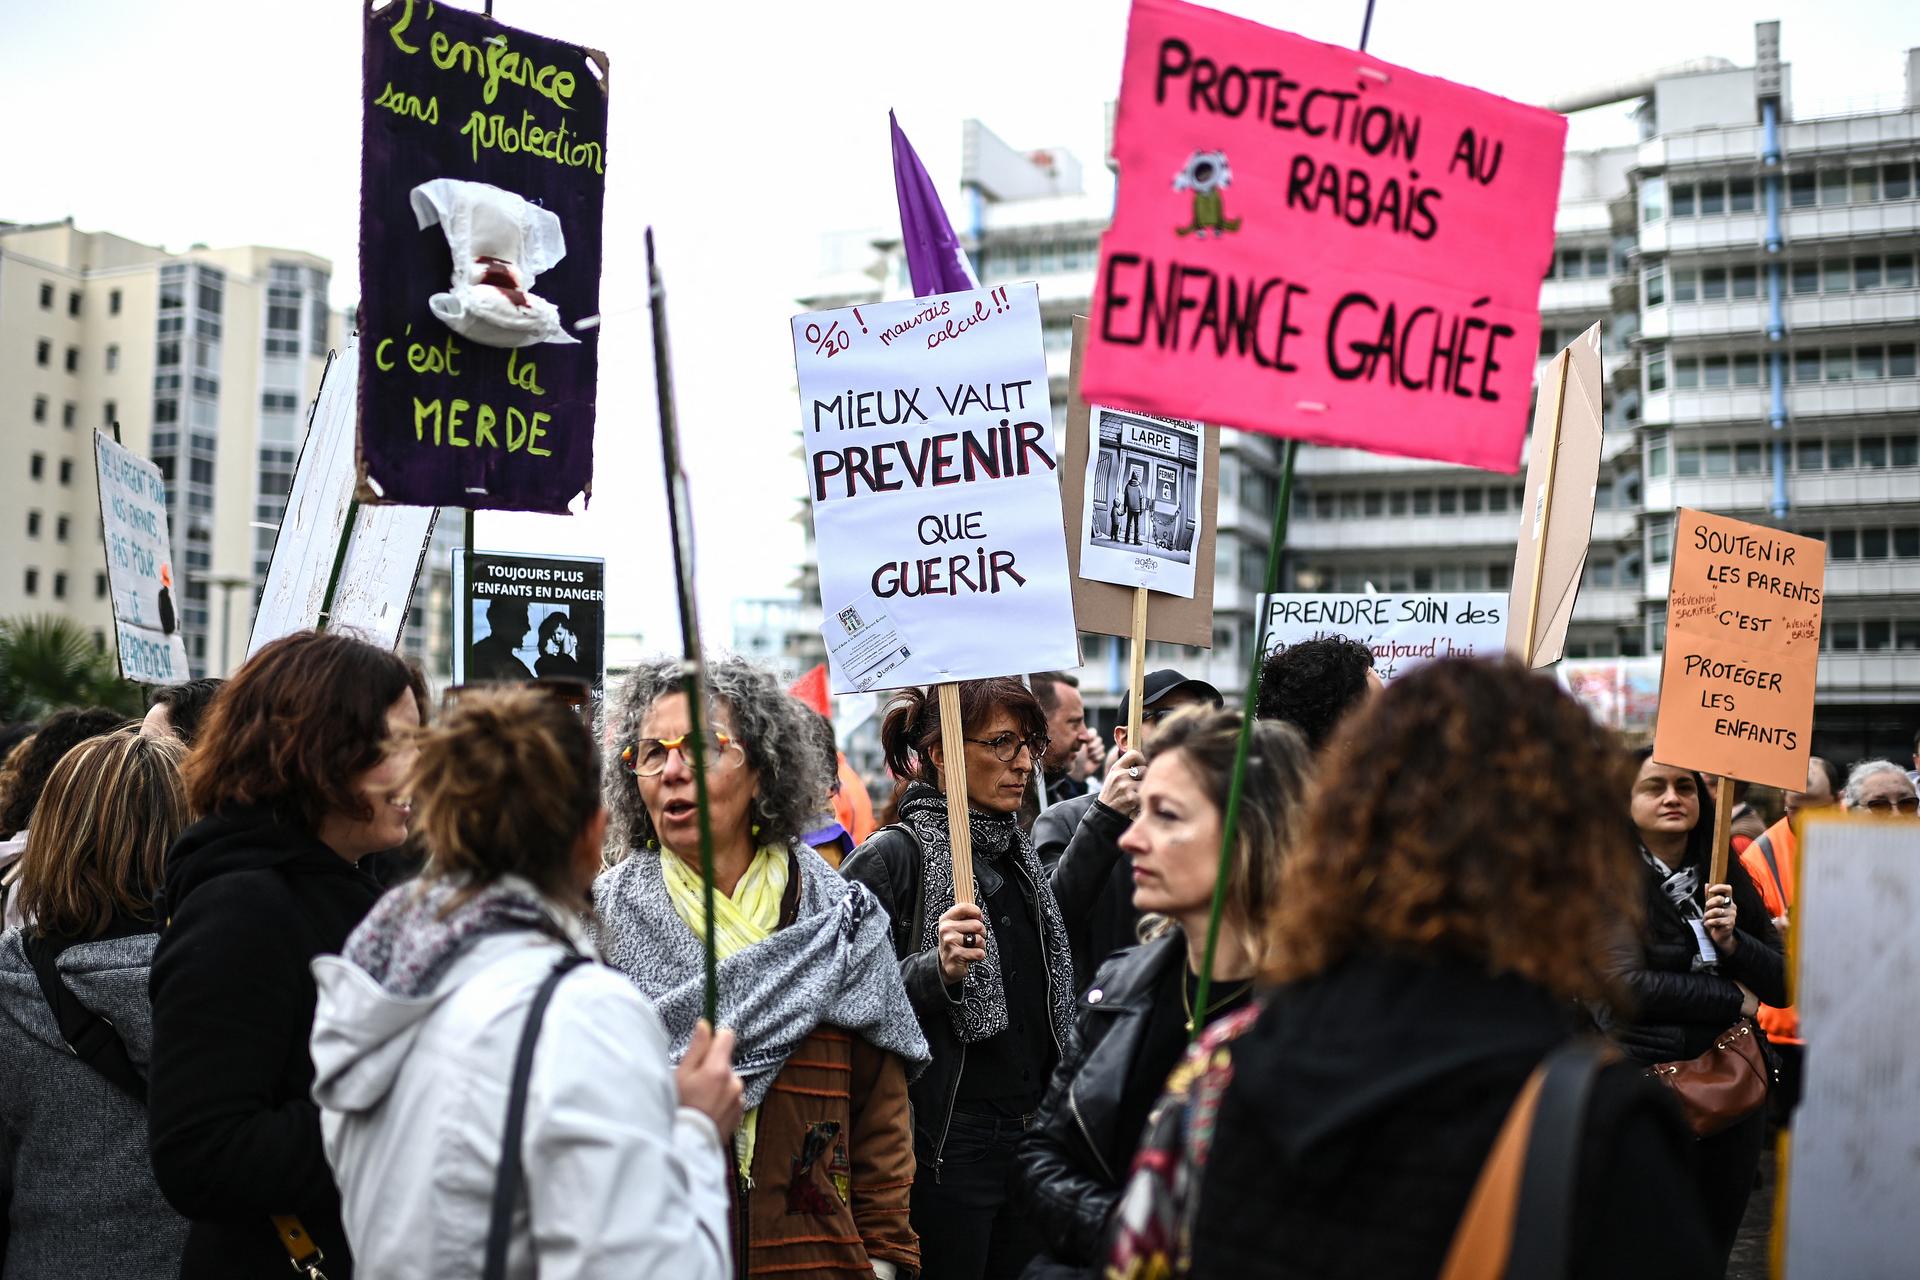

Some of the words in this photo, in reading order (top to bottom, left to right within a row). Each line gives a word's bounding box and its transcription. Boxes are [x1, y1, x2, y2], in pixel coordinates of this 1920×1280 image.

[390, 0, 576, 110] L'enfance
[374, 82, 438, 125] sans
[460, 109, 603, 174] protection
[1449, 127, 1503, 185] AU
[879, 300, 950, 346] mauvais
[1102, 253, 1308, 372] ENFANCE
[1327, 296, 1515, 402] GACHÉE
[376, 324, 460, 376] c'est
[507, 347, 545, 395] la
[936, 380, 1032, 416] VAUT
[414, 397, 551, 456] MERDE
[1131, 427, 1171, 450] LARPE
[917, 511, 987, 546] QUE
[112, 532, 128, 569] PAS
[132, 542, 157, 578] POUR
[487, 565, 551, 581] TOUJOURS
[553, 570, 584, 583] PLUS
[535, 587, 552, 598] EN
[555, 587, 603, 601] DANGER
[1707, 564, 1740, 584] LES
[1747, 570, 1820, 605] PARENTS
[1269, 599, 1392, 626] PRENDRE
[1455, 601, 1500, 625] des
[1719, 610, 1772, 632] C'EST
[1684, 654, 1782, 693] PROTEGER
[1701, 690, 1735, 712] LES
[1715, 719, 1796, 751] ENFANTS
